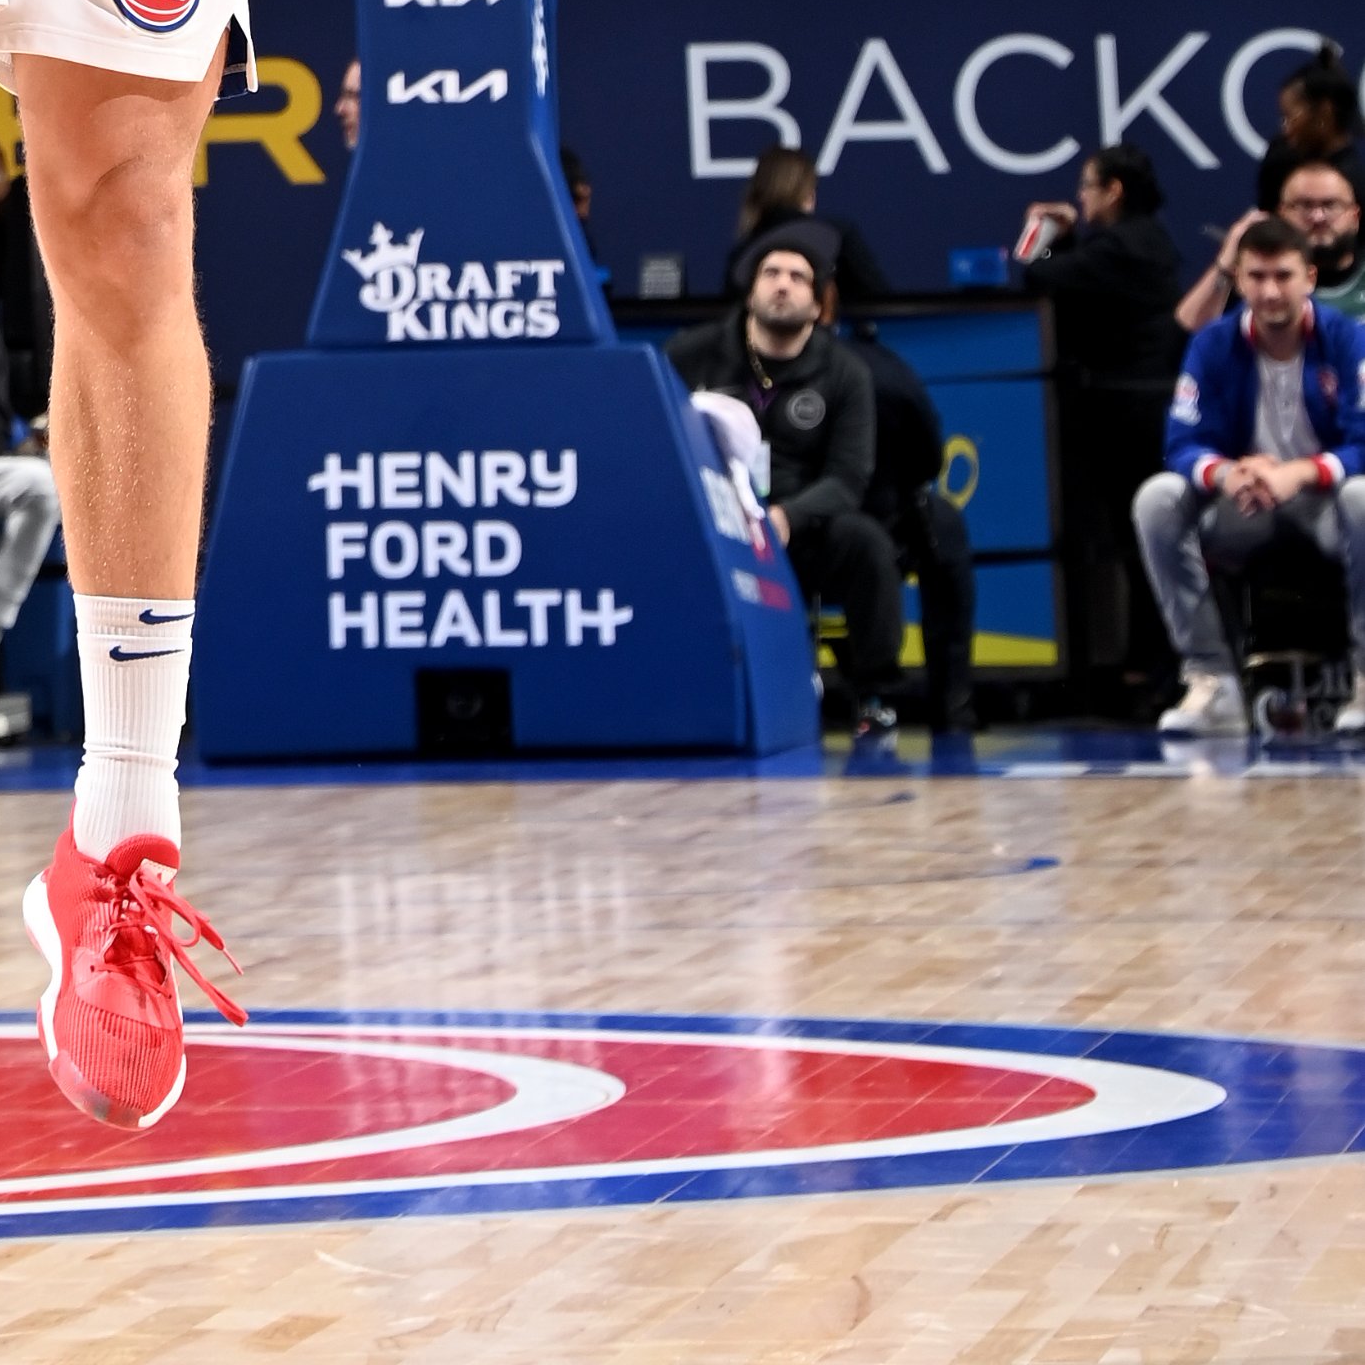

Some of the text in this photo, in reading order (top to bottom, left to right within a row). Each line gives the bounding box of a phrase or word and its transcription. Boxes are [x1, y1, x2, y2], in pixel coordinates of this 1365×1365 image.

[686, 27, 1365, 179] BACKC
[359, 260, 564, 313] DRAFT
[386, 301, 561, 342] KINGS
[308, 449, 578, 509] HENRY
[326, 520, 522, 579] FORD
[329, 588, 634, 650] HEALTH
